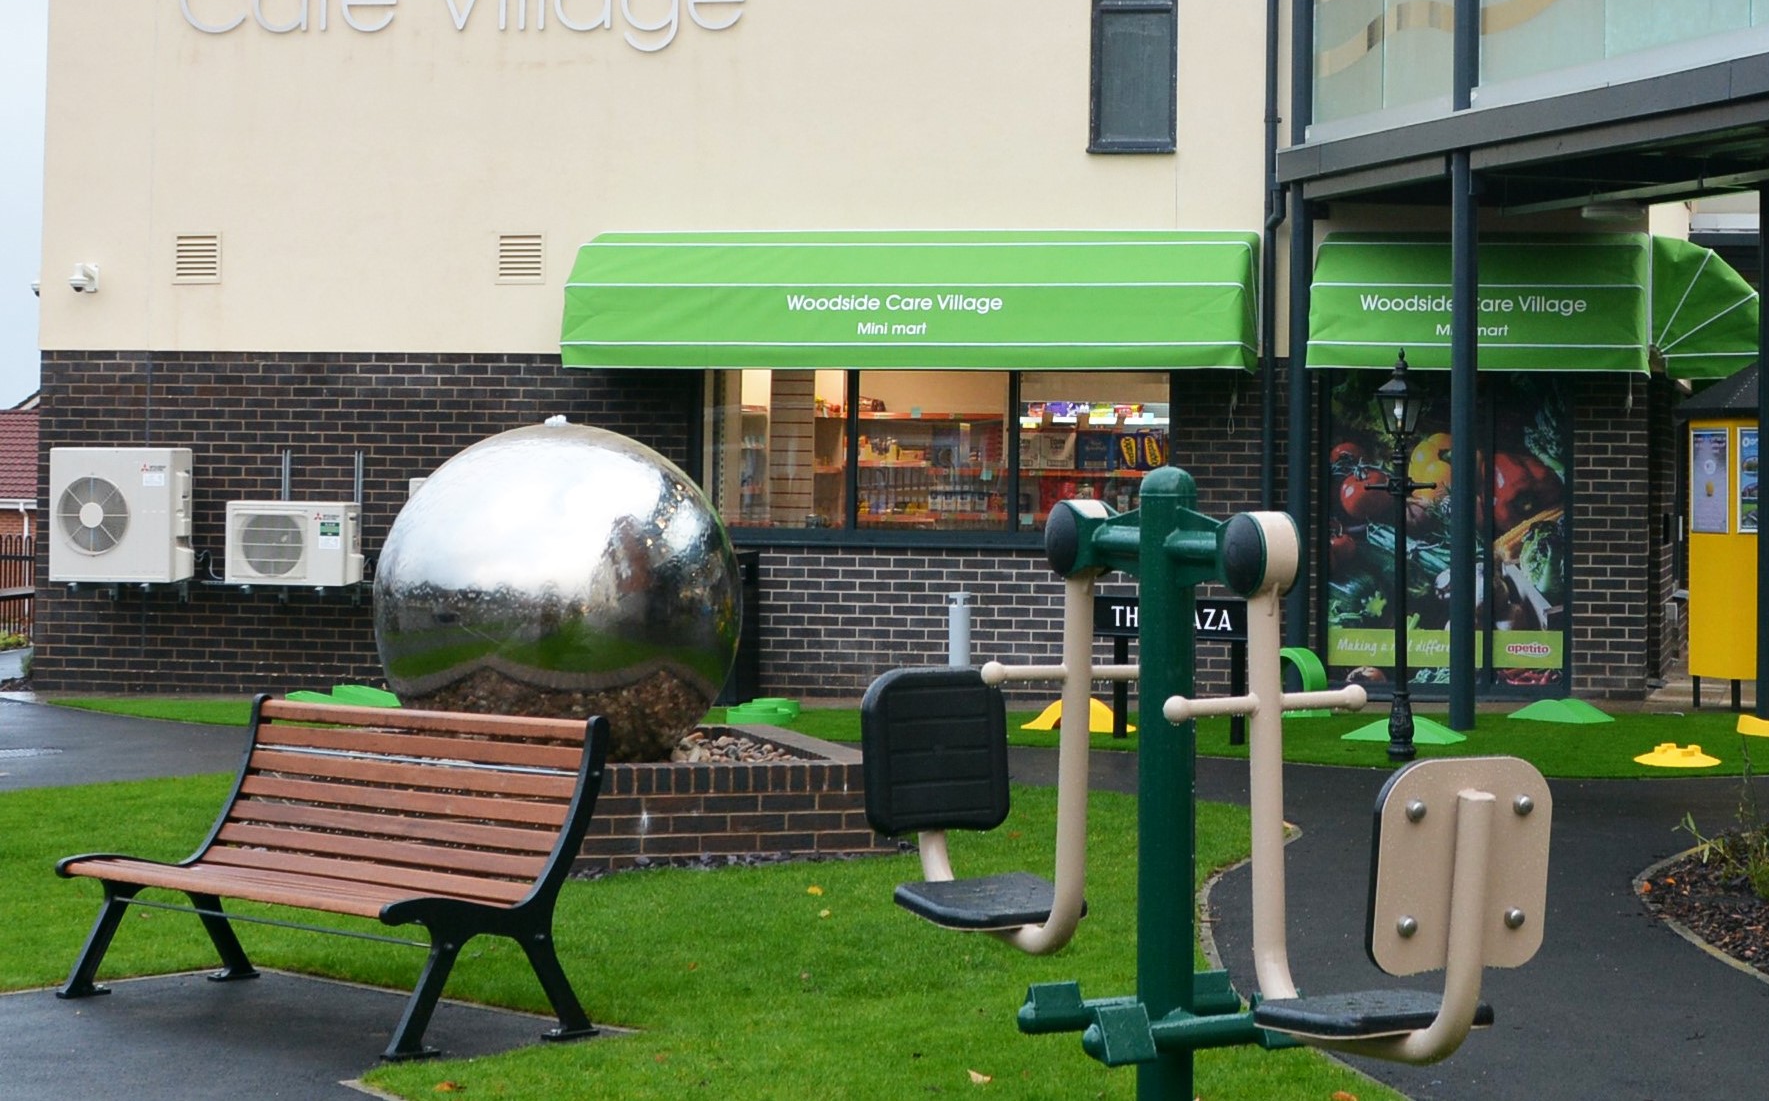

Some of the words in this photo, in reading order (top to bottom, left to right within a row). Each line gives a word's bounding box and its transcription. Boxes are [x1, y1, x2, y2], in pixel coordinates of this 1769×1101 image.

[786, 294, 881, 311] Woodside
[885, 294, 933, 311] Care
[937, 294, 1003, 314] Village
[1477, 296, 1514, 312] are
[1518, 295, 1587, 316] Village
[857, 322, 888, 335] Mini
[892, 322, 927, 335] mart
[1111, 605, 1139, 628] TH
[1193, 608, 1233, 631] AZA
[1336, 637, 1378, 657] Making
[1380, 642, 1389, 652] a
[1507, 642, 1550, 655] apetito
